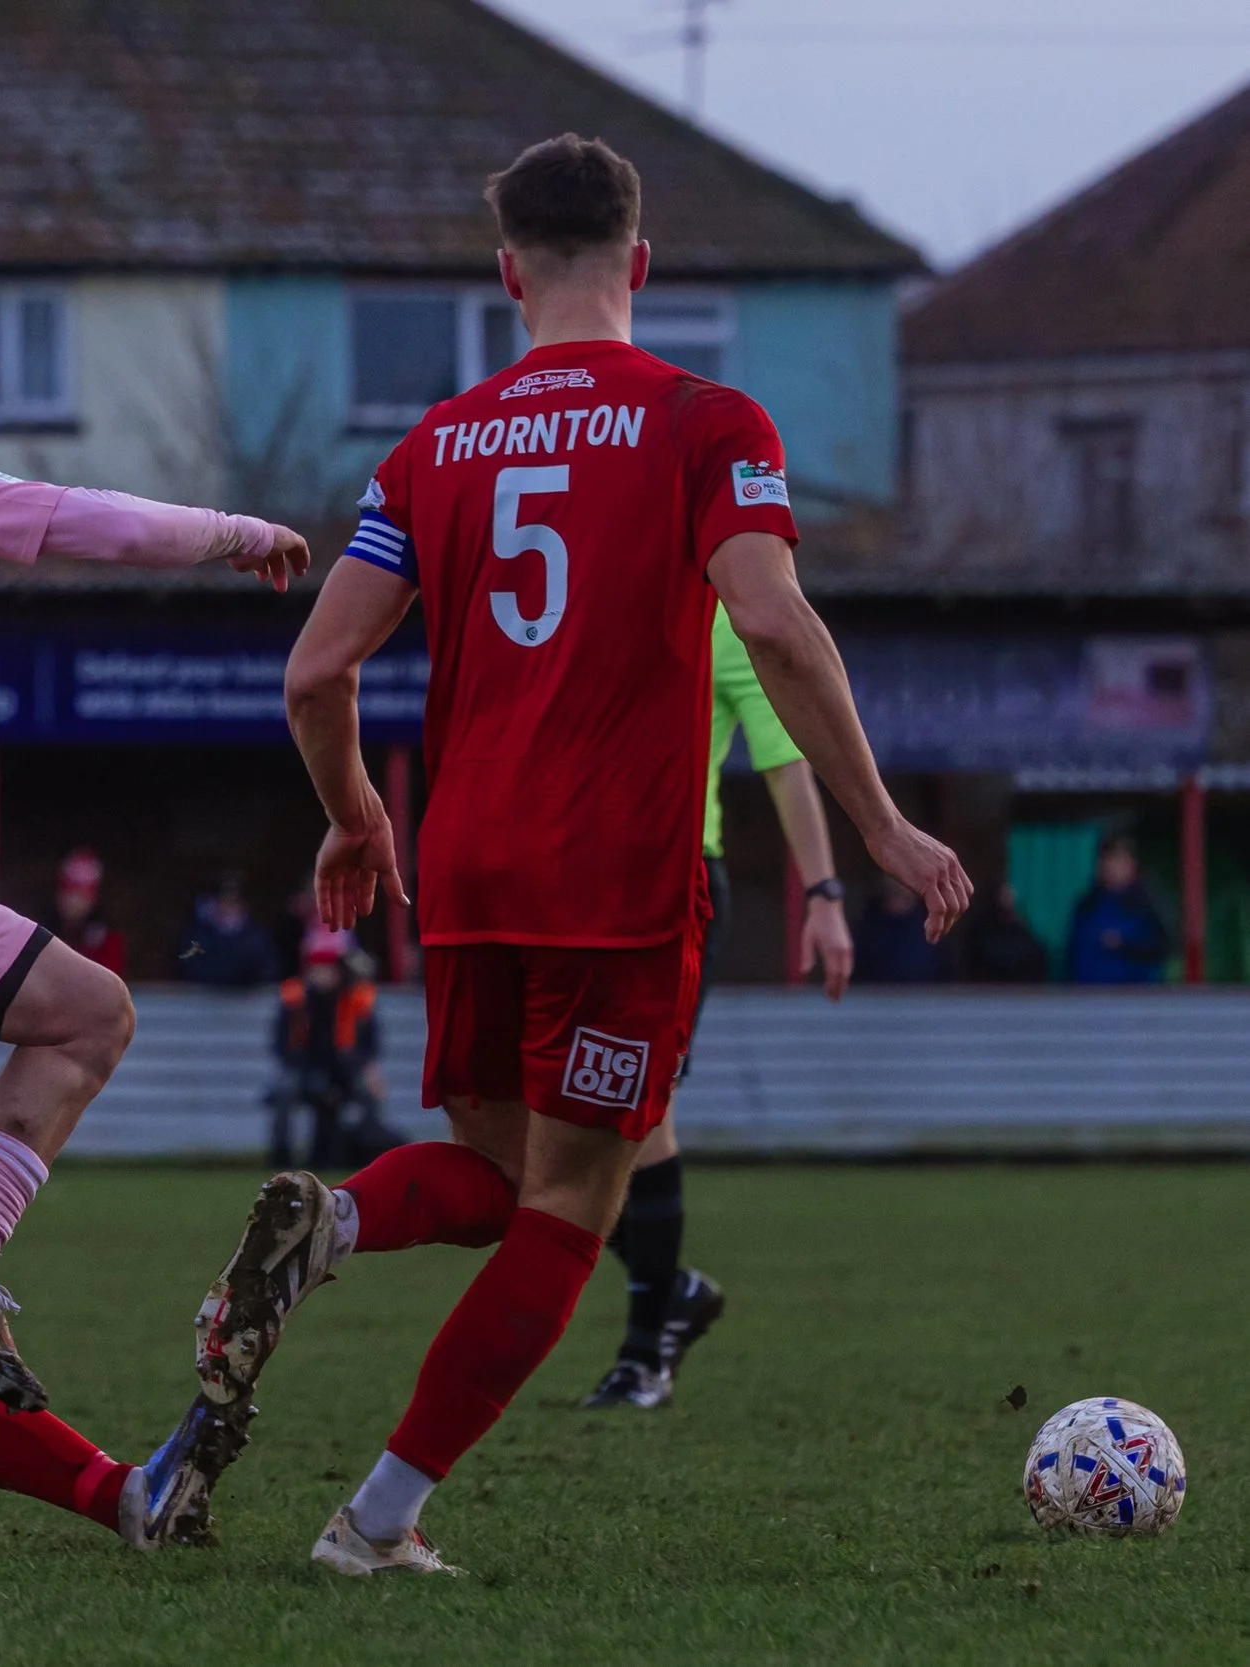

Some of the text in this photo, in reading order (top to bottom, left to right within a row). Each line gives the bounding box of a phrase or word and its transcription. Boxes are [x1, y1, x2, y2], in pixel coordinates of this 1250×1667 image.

[432, 404, 646, 468] THORNTON
[490, 464, 570, 648] 5
[572, 1067, 635, 1101] OLI
[580, 1039, 639, 1078] TIG
